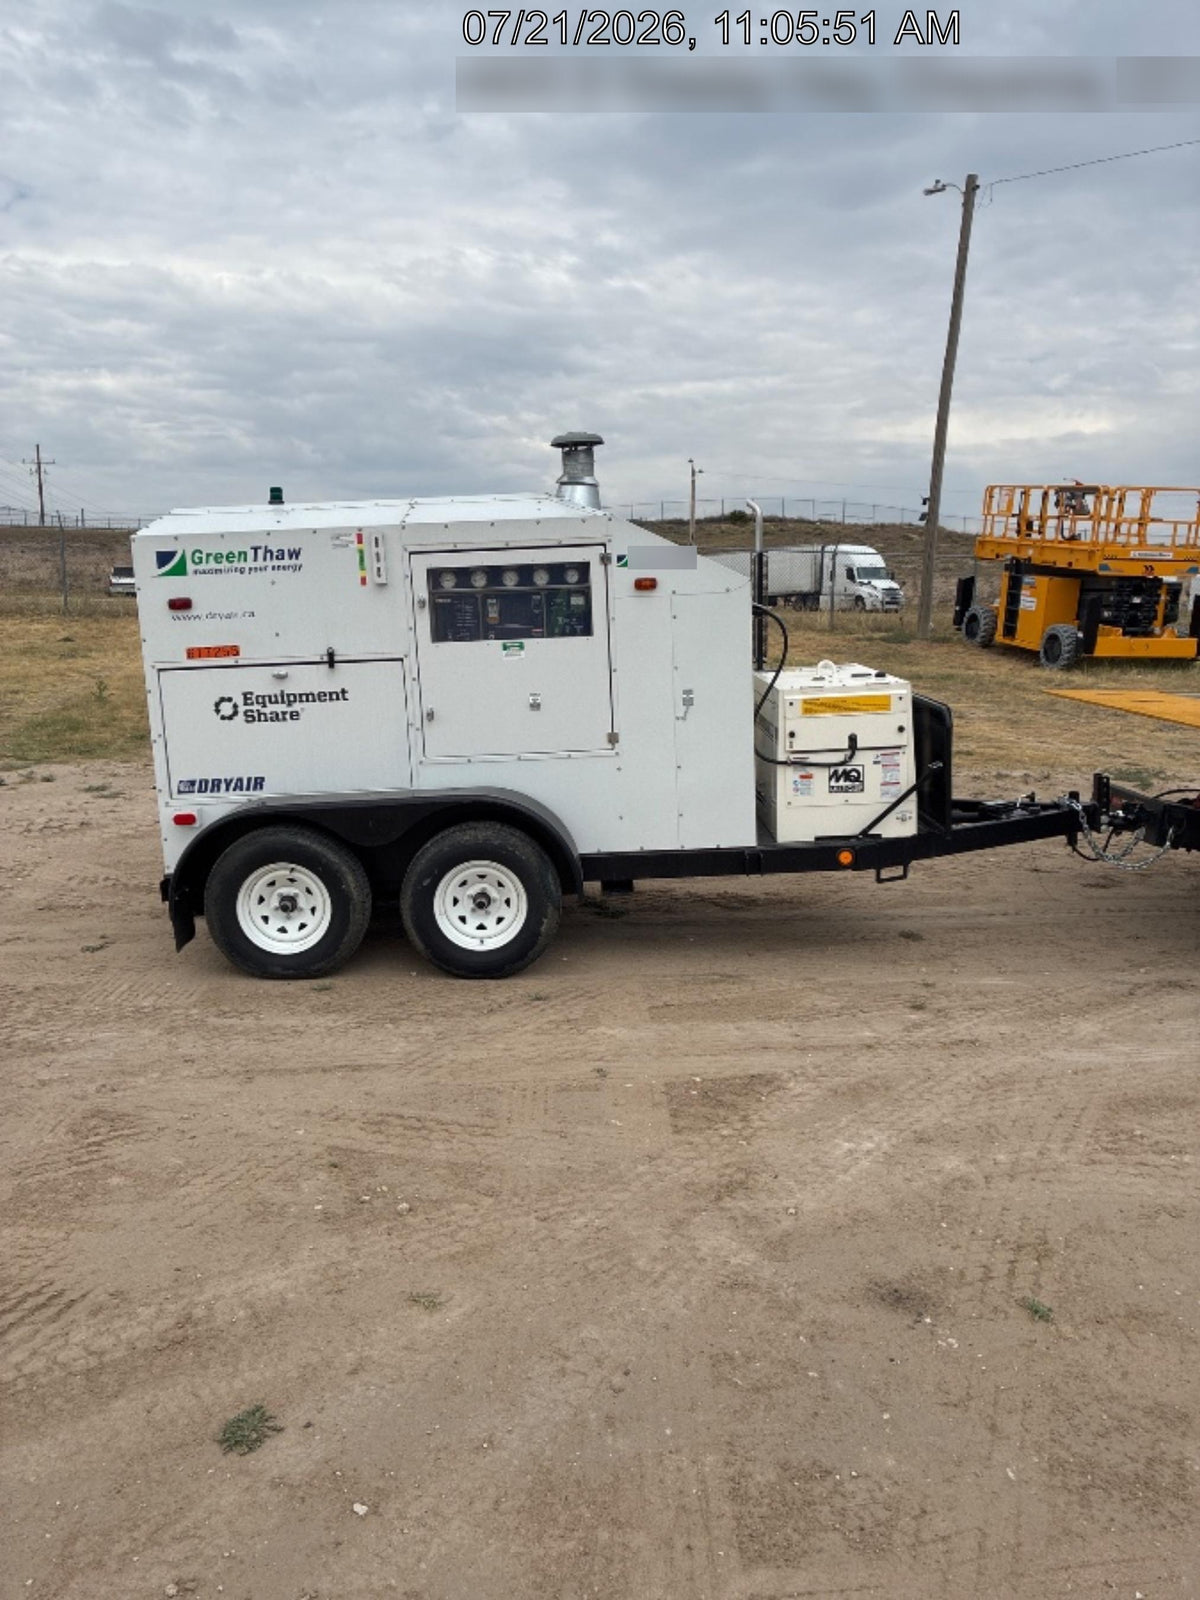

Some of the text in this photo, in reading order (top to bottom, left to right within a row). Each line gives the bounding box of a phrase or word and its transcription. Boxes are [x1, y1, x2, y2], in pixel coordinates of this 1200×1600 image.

[248, 565, 268, 575] your
[271, 563, 303, 573] energy
[241, 687, 349, 708] Equipment
[243, 709, 301, 724] Share
[197, 776, 265, 794] DRYAIR
